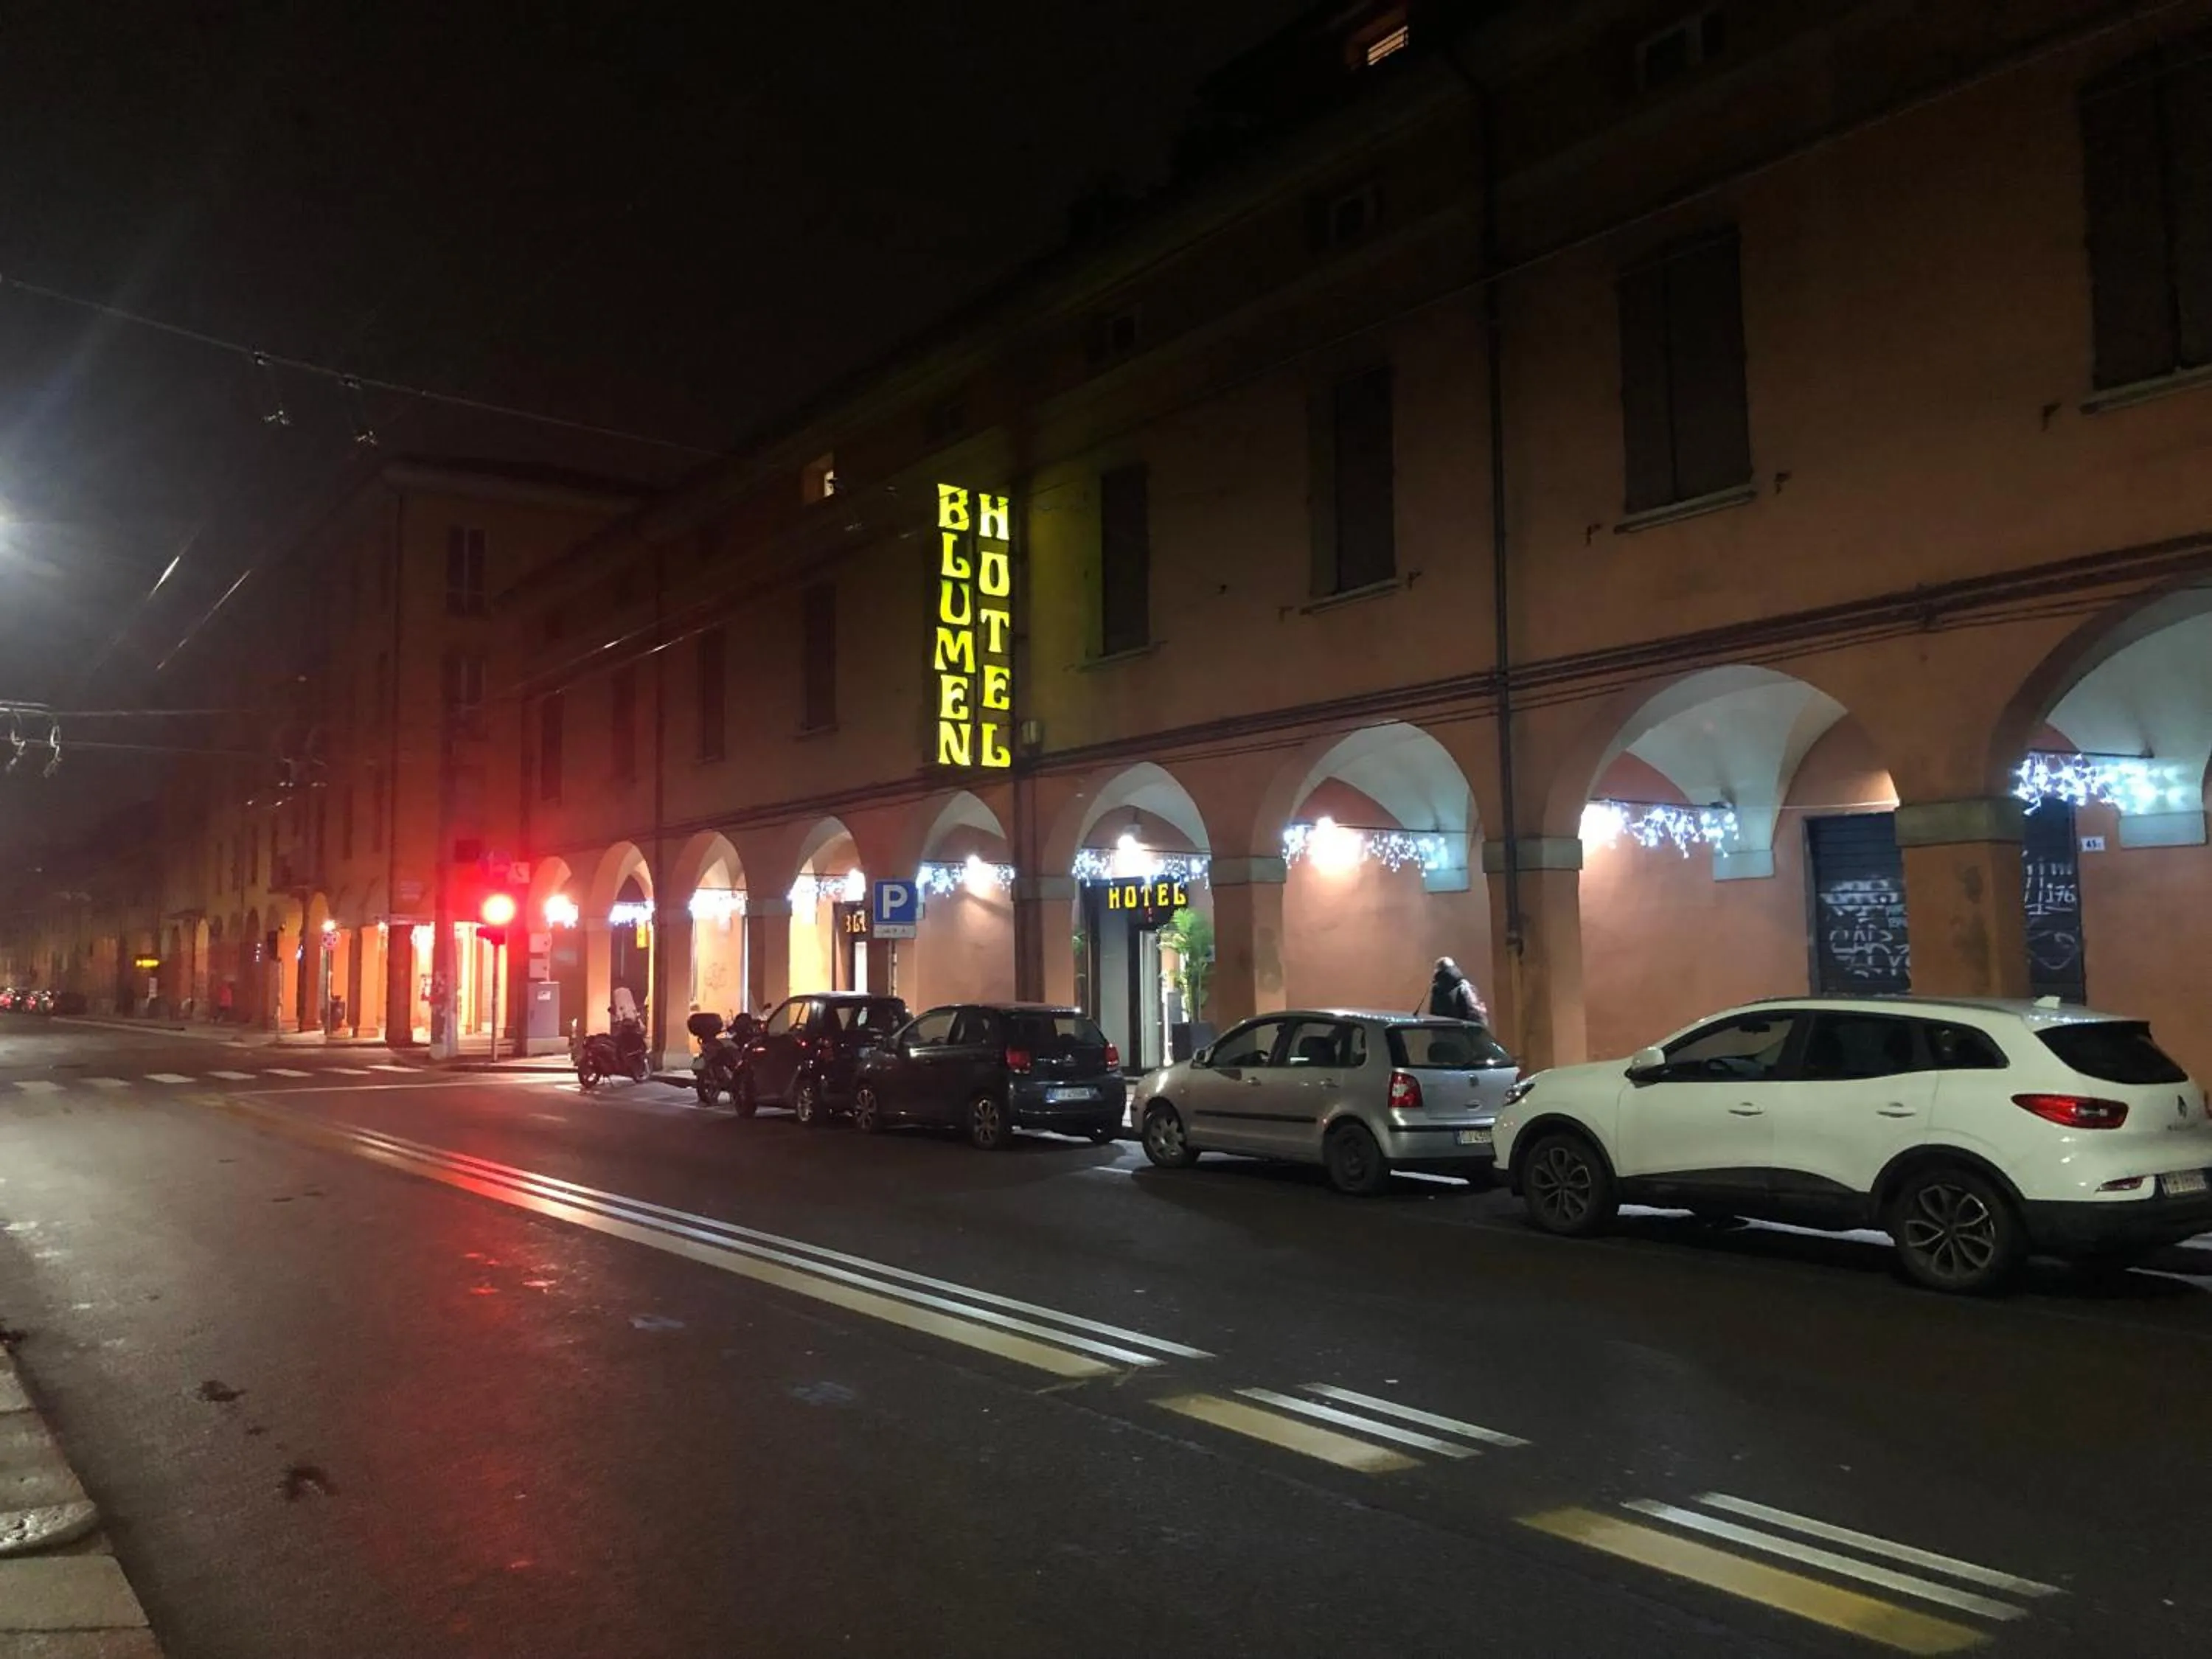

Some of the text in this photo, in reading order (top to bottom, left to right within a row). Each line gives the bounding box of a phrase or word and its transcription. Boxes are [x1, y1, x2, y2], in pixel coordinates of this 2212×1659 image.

[935, 483, 975, 766] BLUMEN
[978, 493, 1010, 768] HOTEL
[883, 884, 908, 919] P
[1108, 883, 1186, 908] HOTEL
